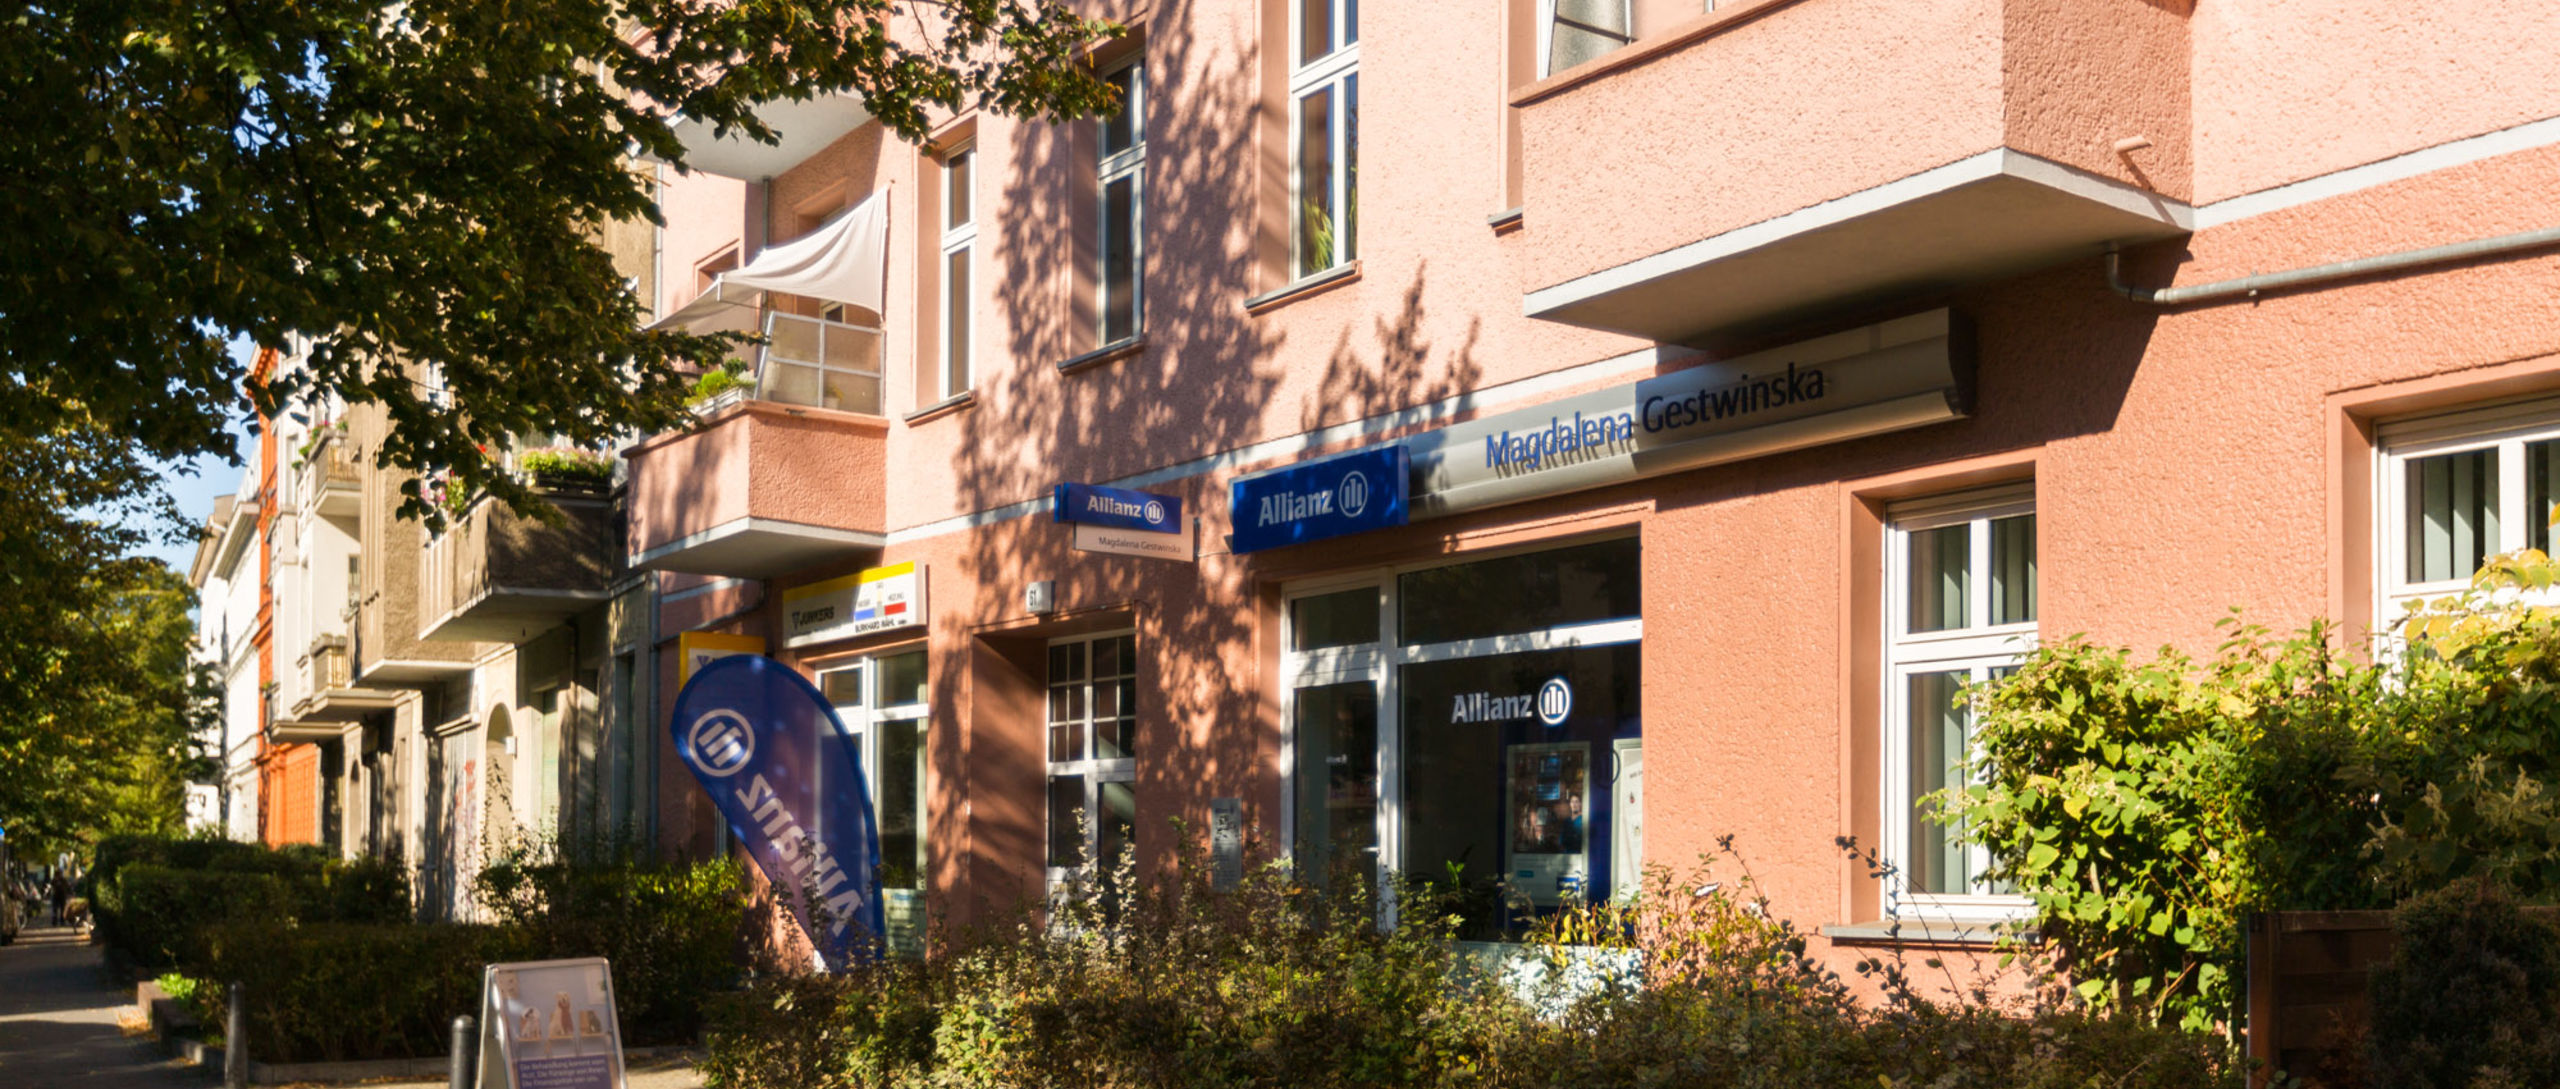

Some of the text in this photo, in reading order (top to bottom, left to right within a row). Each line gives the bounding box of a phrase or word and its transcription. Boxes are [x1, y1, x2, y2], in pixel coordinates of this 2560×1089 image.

[1485, 362, 1824, 469] Magdalena Gestwinska
[1087, 495, 1142, 518] Allianz
[1258, 490, 1334, 528] Allianz
[1098, 536, 1182, 553] Magdalena Gestwinska
[1451, 691, 1533, 724] Allianz
